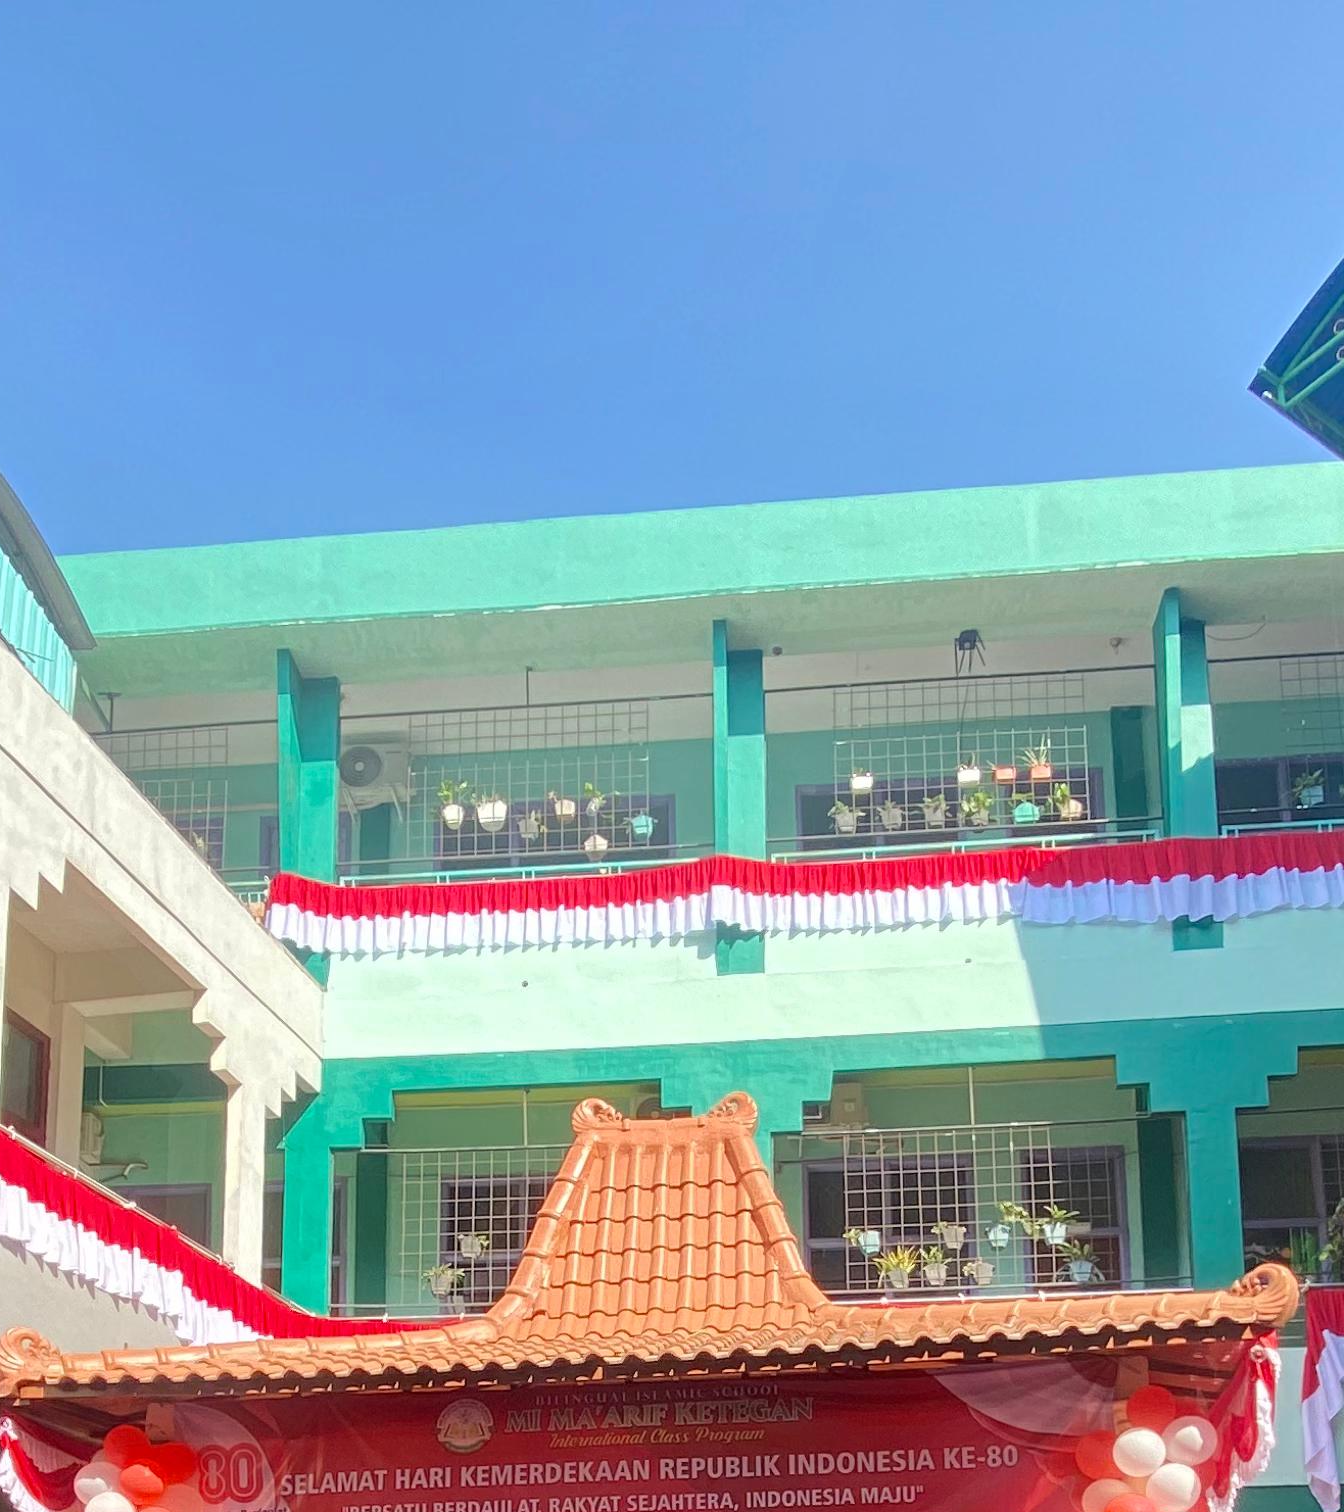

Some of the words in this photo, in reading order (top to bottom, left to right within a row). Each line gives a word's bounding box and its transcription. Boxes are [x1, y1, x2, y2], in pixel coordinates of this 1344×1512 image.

[504, 1409, 542, 1433] MI
[674, 1397, 814, 1425] KETEGAN
[549, 1426, 645, 1448] International
[650, 1427, 689, 1444] Class
[696, 1425, 765, 1443] Program
[199, 1443, 264, 1504] 80
[280, 1469, 388, 1496] SELAMAT
[395, 1467, 452, 1489] HARI
[460, 1460, 650, 1488] KEMERDEKAAN
[659, 1454, 780, 1480] REPUBLIK
[789, 1449, 935, 1475] INDONESIA
[943, 1445, 1019, 1470] KE-80
[626, 1491, 739, 1512] SEJAHTERA,
[746, 1489, 855, 1509] INDONESIA
[860, 1484, 924, 1504] MAJU"
